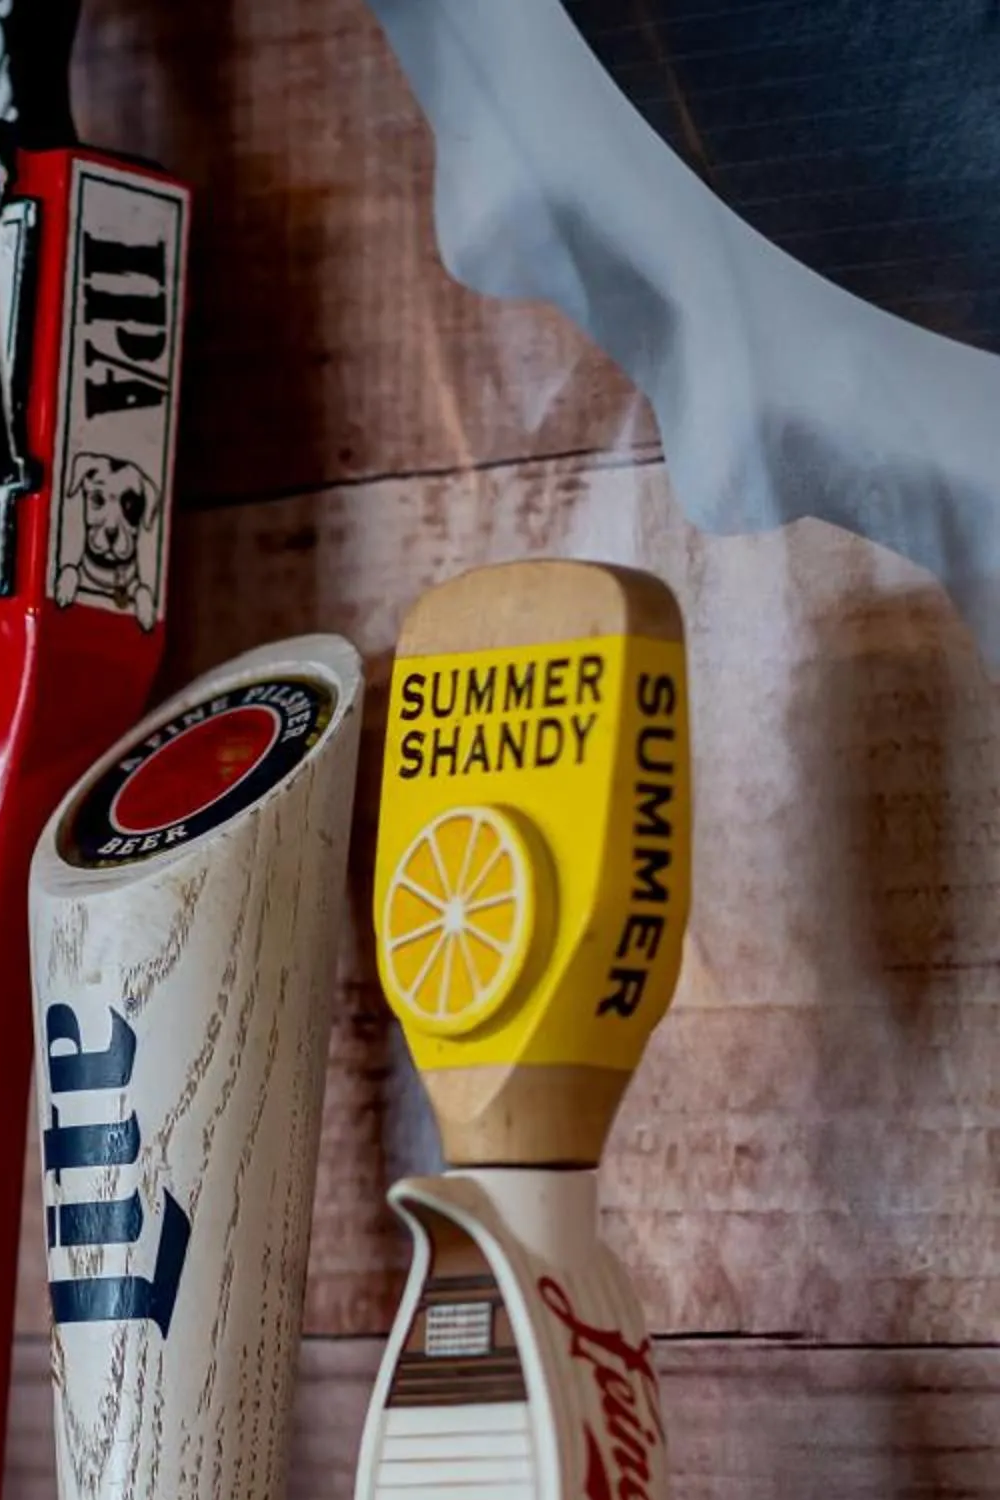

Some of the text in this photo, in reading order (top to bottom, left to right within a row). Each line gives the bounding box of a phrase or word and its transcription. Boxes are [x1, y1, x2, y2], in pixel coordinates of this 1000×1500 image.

[83, 230, 170, 420] IPA
[241, 684, 313, 744] PILSNER
[399, 654, 605, 722] SUMMER
[398, 713, 598, 780] SHANDY
[97, 823, 190, 857] BEER
[596, 672, 676, 1021] SUMMER
[43, 1003, 191, 1341] Lite
